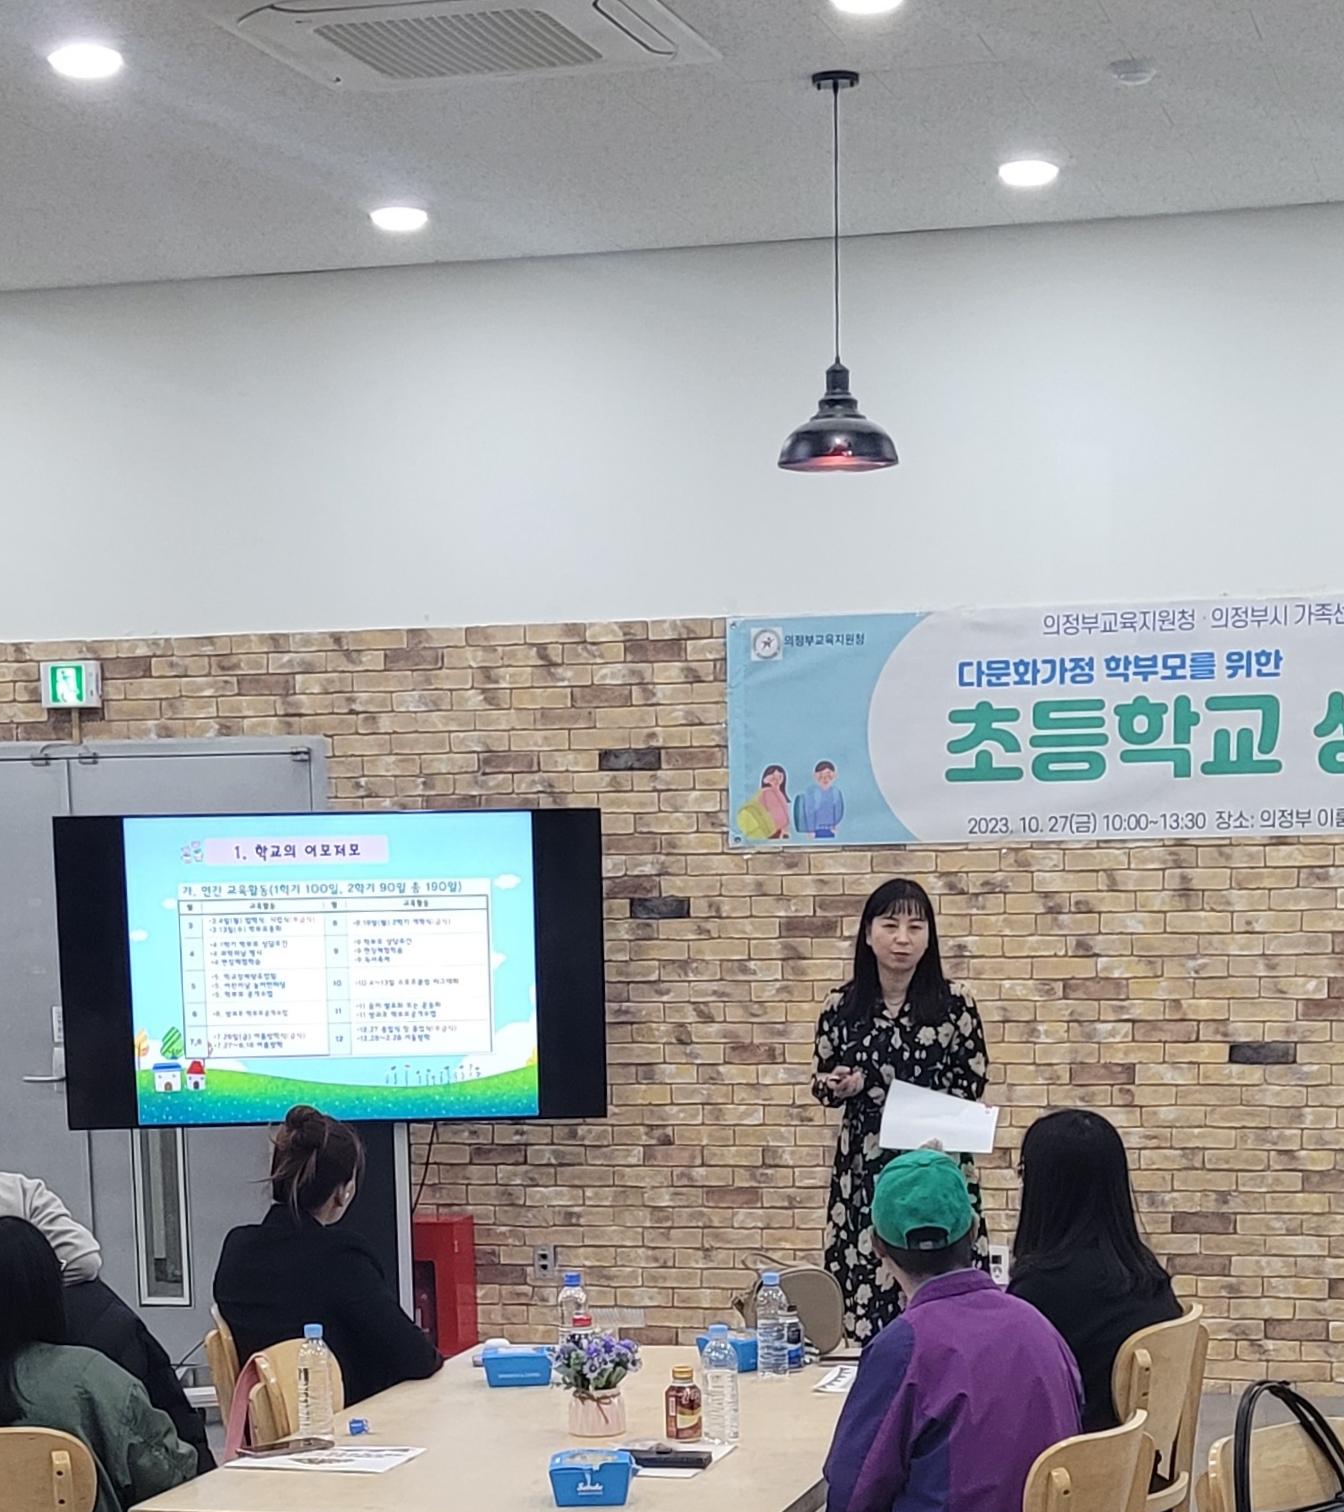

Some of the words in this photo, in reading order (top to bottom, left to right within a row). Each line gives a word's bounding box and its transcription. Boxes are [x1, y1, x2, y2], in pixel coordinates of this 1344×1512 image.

[1043, 609, 1196, 636] 의정부교육지원청
[1210, 604, 1288, 629] 의정부시
[783, 632, 866, 648] 의정부교육지원청
[957, 656, 1095, 689] 다문화가정
[1104, 651, 1216, 683] 학부모를
[1224, 648, 1284, 679] 위한
[944, 692, 1284, 783] 초등학교
[967, 817, 1013, 835] 2023.
[1018, 816, 1044, 834] 10.
[1047, 813, 1097, 835] 27(금)
[1102, 811, 1207, 832] 10:00~13:30
[1214, 809, 1255, 830] 장소:
[1259, 808, 1313, 829] 의정부
[234, 845, 247, 861] 1.
[255, 843, 296, 861] 학교의
[182, 886, 196, 897] 가.
[201, 885, 222, 897] 연간
[347, 882, 375, 894] 2학기
[379, 881, 406, 894] 90일
[425, 880, 463, 893] 190일)
